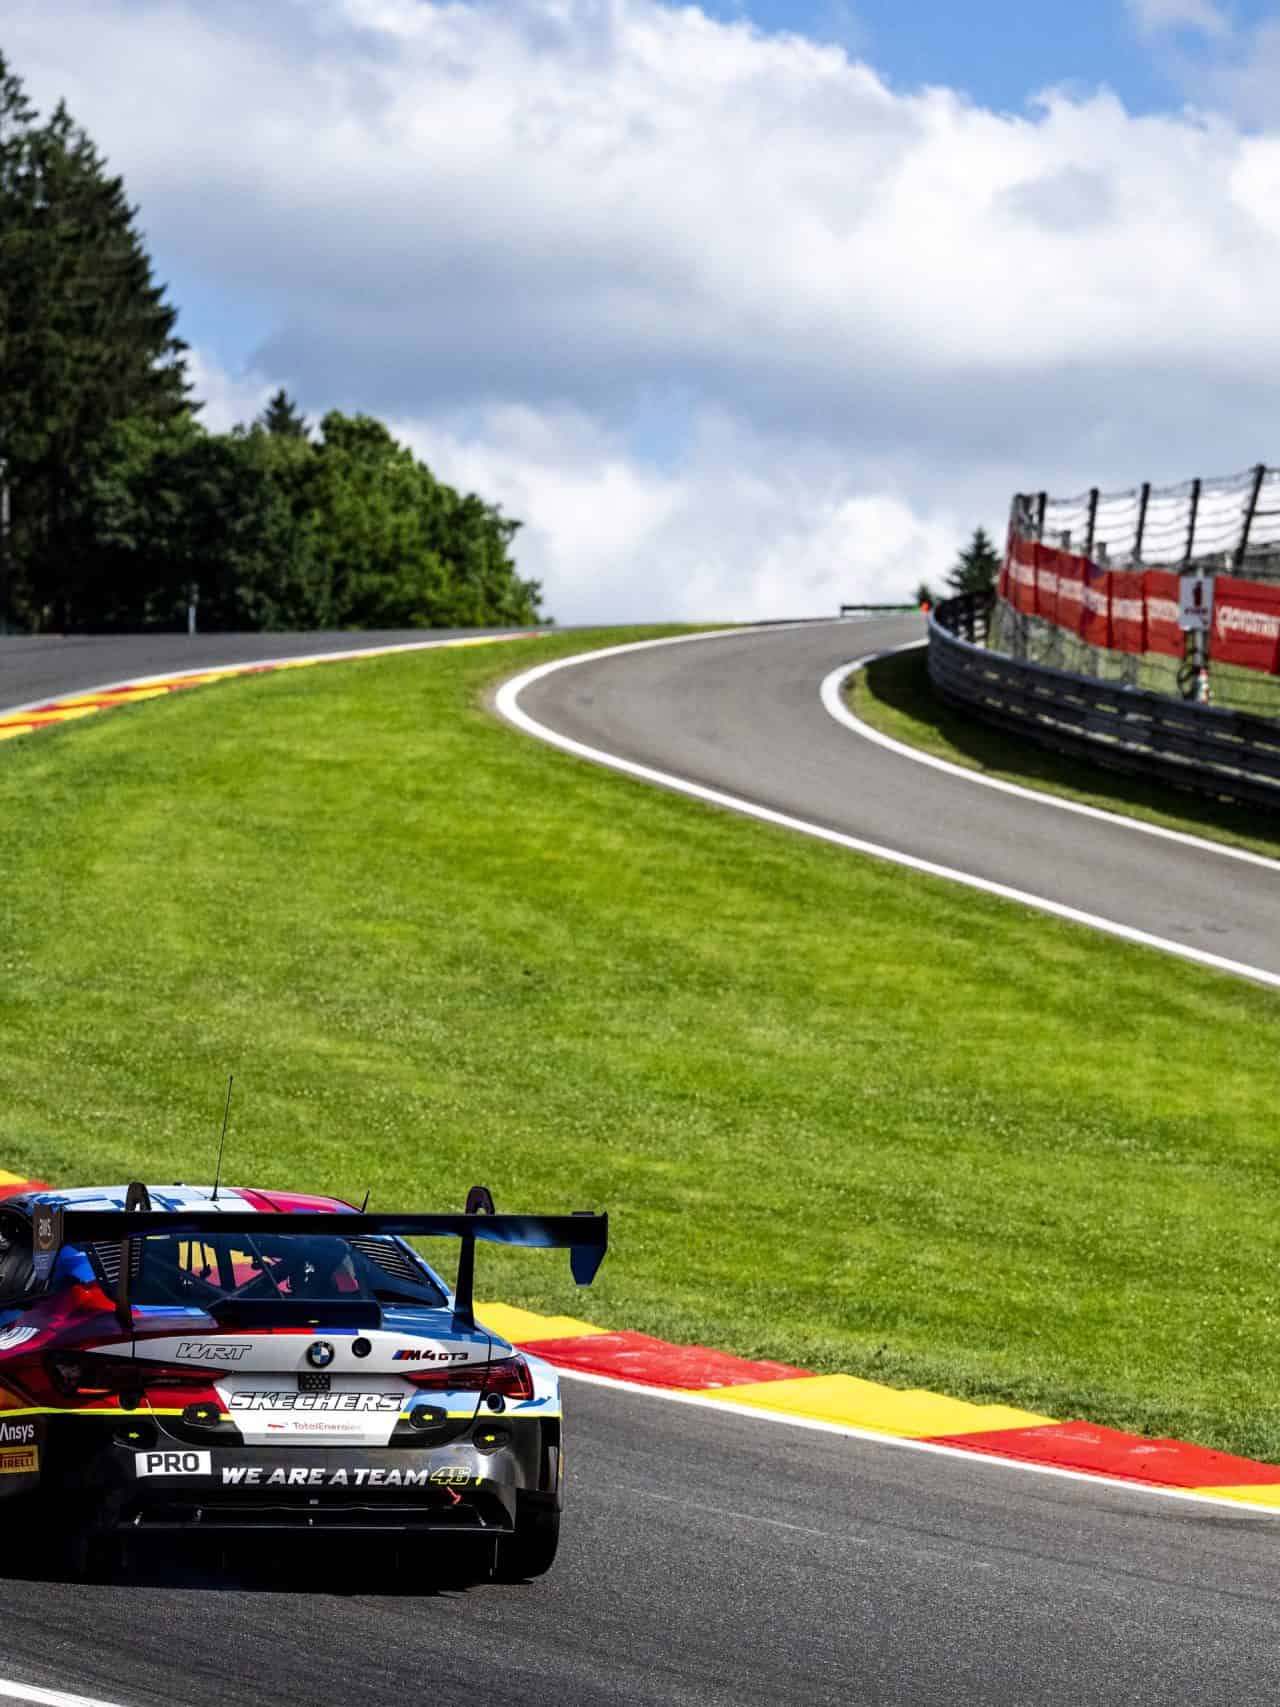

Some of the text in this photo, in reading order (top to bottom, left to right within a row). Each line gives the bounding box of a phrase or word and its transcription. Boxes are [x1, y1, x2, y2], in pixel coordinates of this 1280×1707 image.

[176, 1343, 252, 1360] WRT
[439, 1352, 469, 1361] GT3
[228, 1391, 405, 1412] SKECHERS
[0, 1422, 35, 1444] Ansys
[146, 1453, 200, 1473] PRO
[222, 1467, 261, 1485] WE
[267, 1467, 325, 1485] ARE
[327, 1468, 349, 1485] A
[354, 1467, 429, 1486] TEAM
